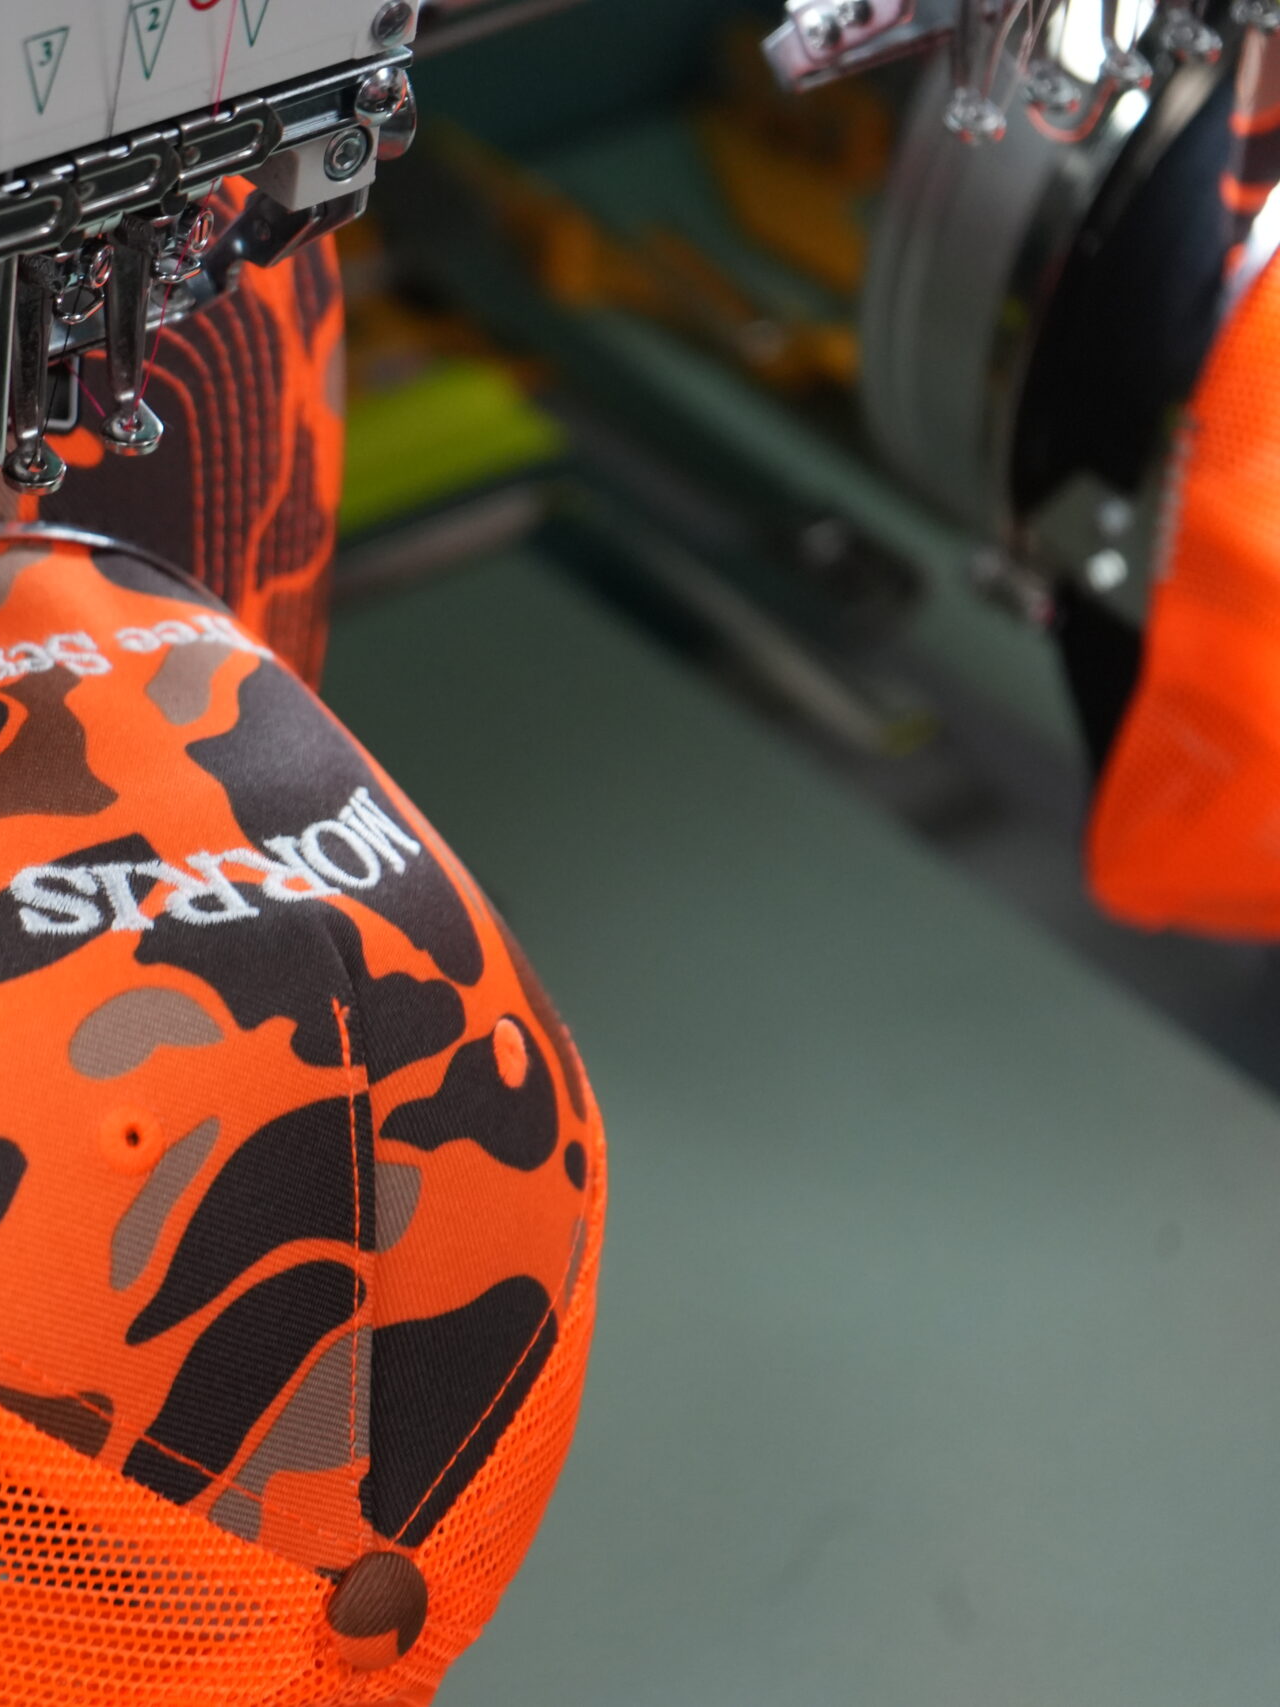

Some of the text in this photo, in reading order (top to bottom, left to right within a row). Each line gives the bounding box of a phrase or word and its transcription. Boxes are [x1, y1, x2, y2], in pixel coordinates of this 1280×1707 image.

[147, 7, 161, 32] 2
[38, 41, 54, 67] 3
[11, 787, 420, 935] MORRIS
